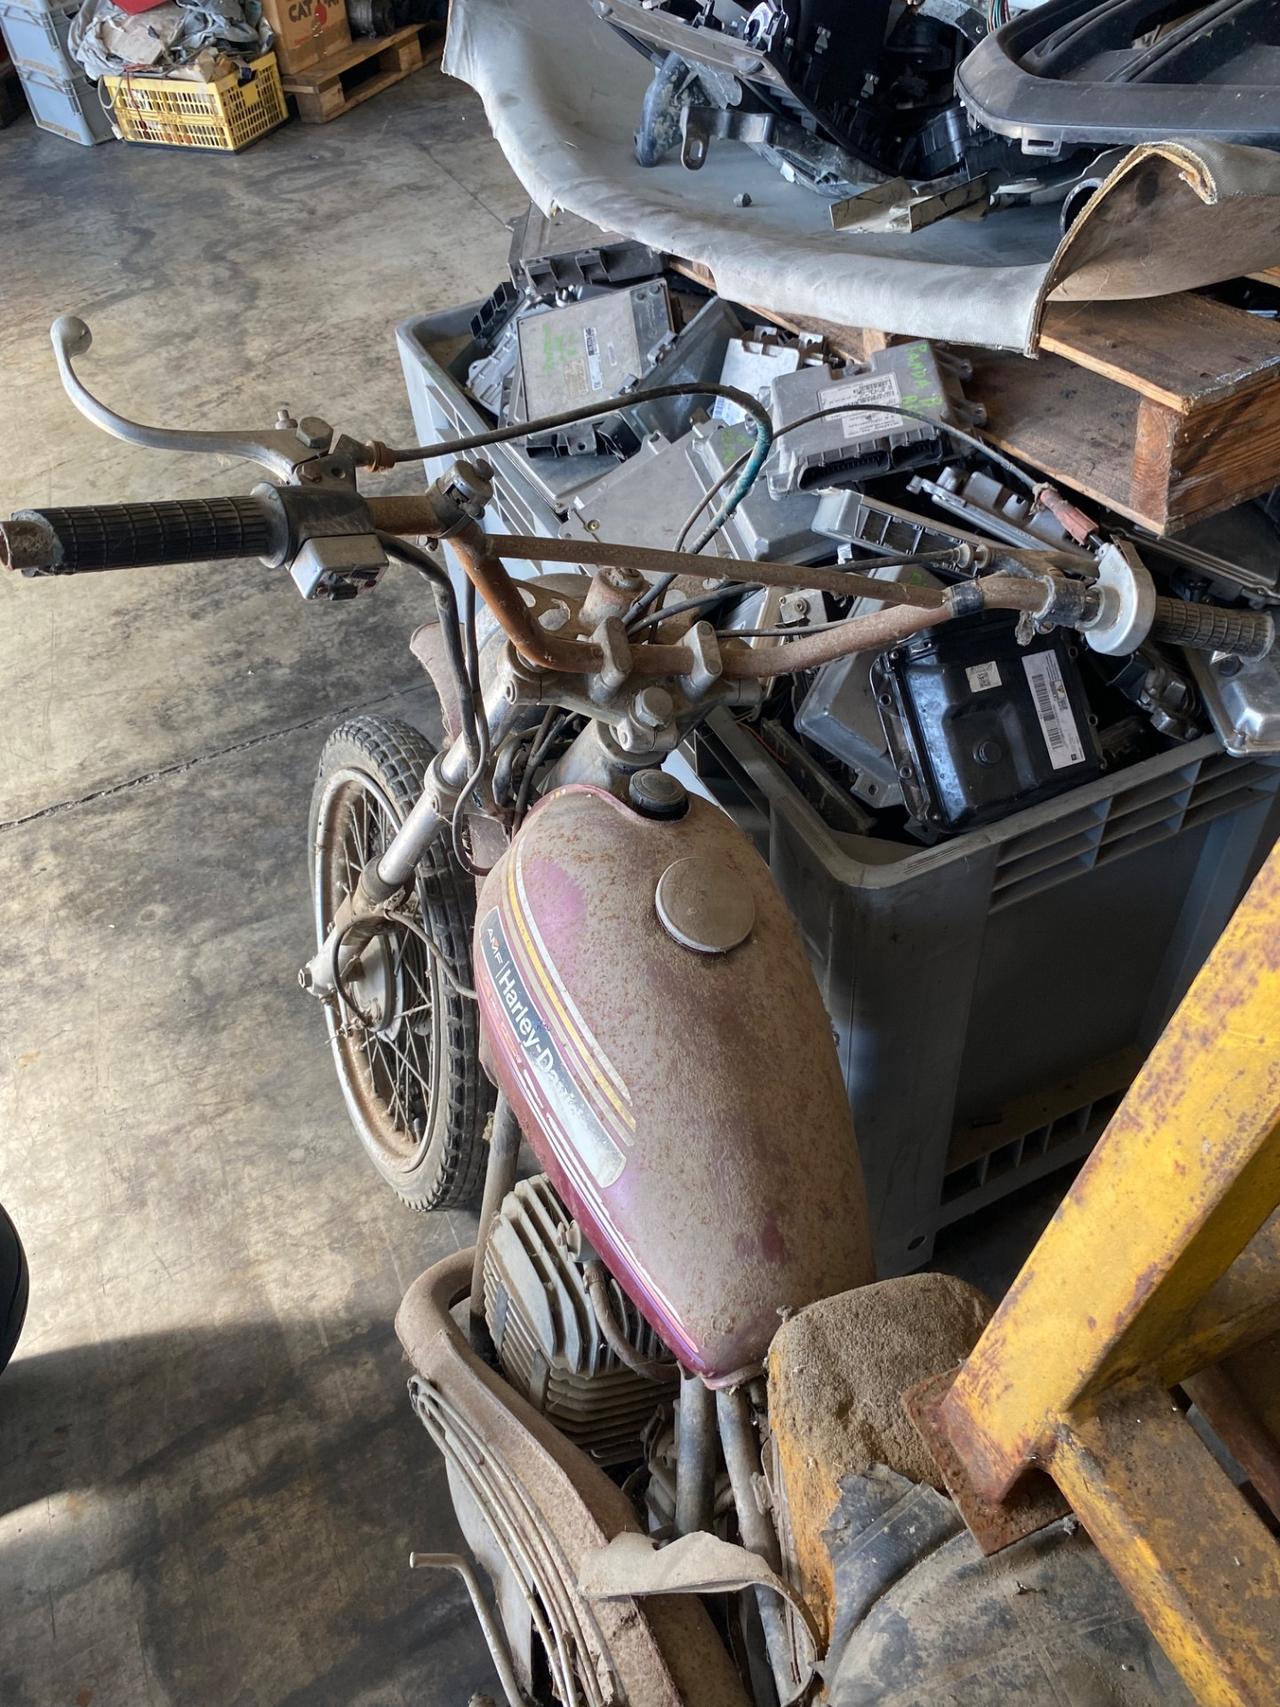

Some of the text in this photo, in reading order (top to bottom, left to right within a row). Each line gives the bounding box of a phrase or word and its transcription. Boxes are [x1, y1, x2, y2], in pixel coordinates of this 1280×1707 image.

[905, 343, 931, 389] PANDA
[487, 928, 586, 1118] AMF Harley-Da
